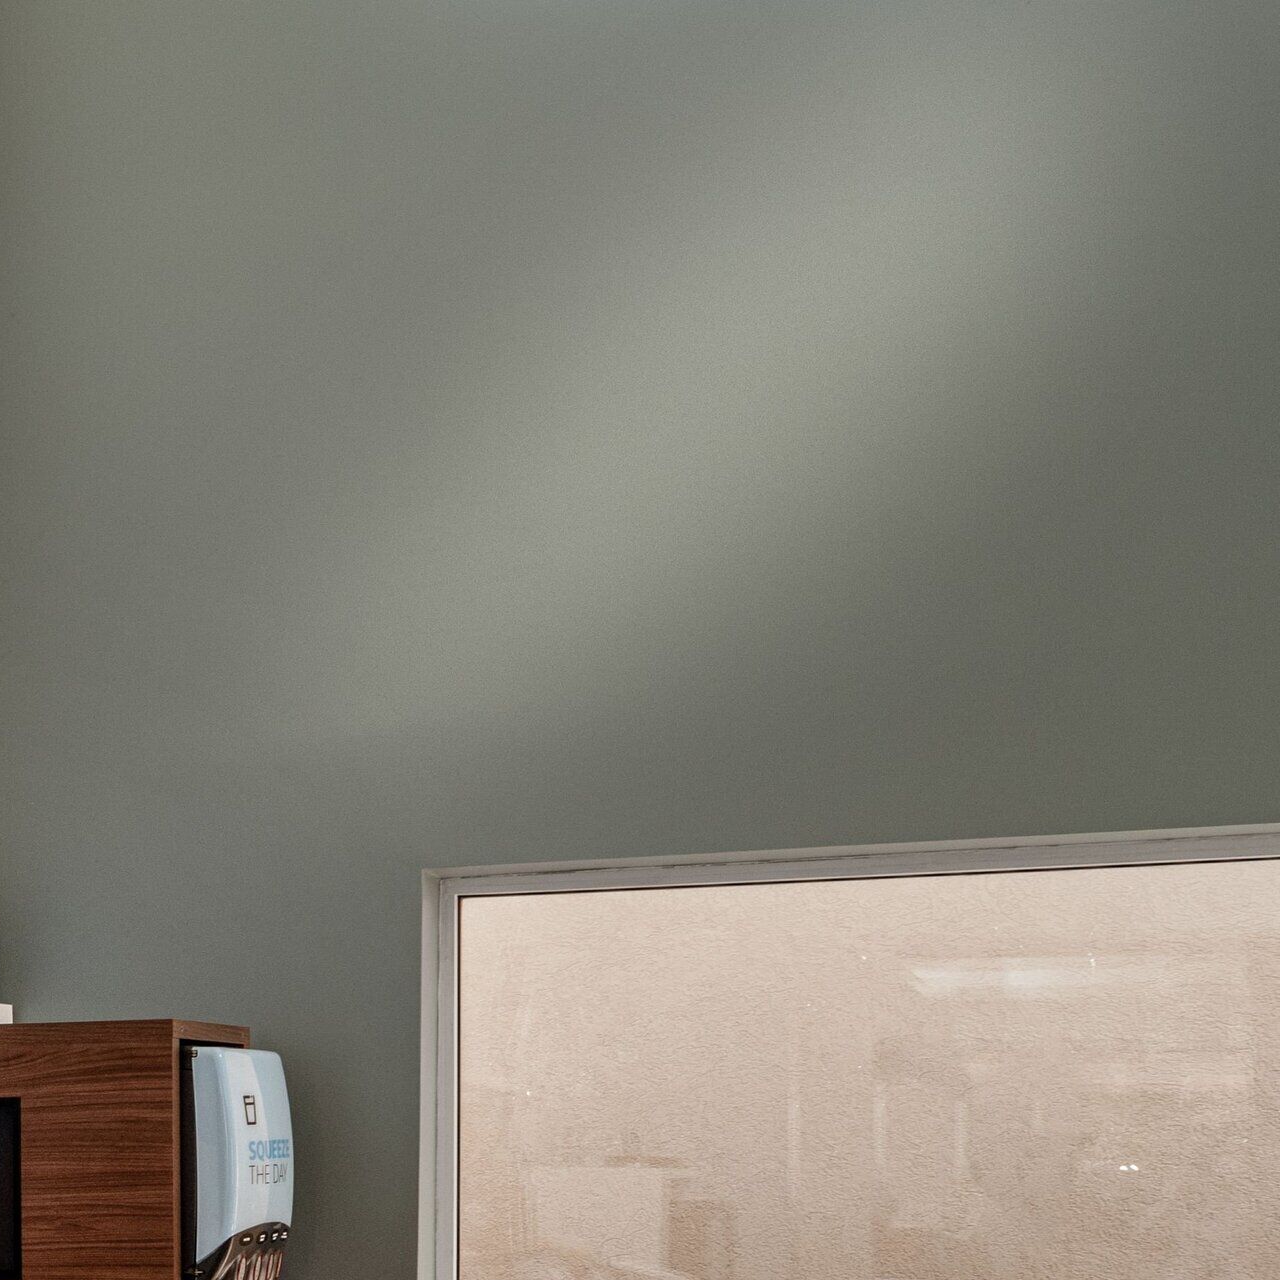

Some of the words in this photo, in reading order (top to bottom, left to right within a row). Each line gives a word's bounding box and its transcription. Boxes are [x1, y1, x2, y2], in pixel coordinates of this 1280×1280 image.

[248, 1138, 290, 1161] SQUEEZE
[248, 1164, 270, 1185] THE
[272, 1162, 288, 1184] DAY
